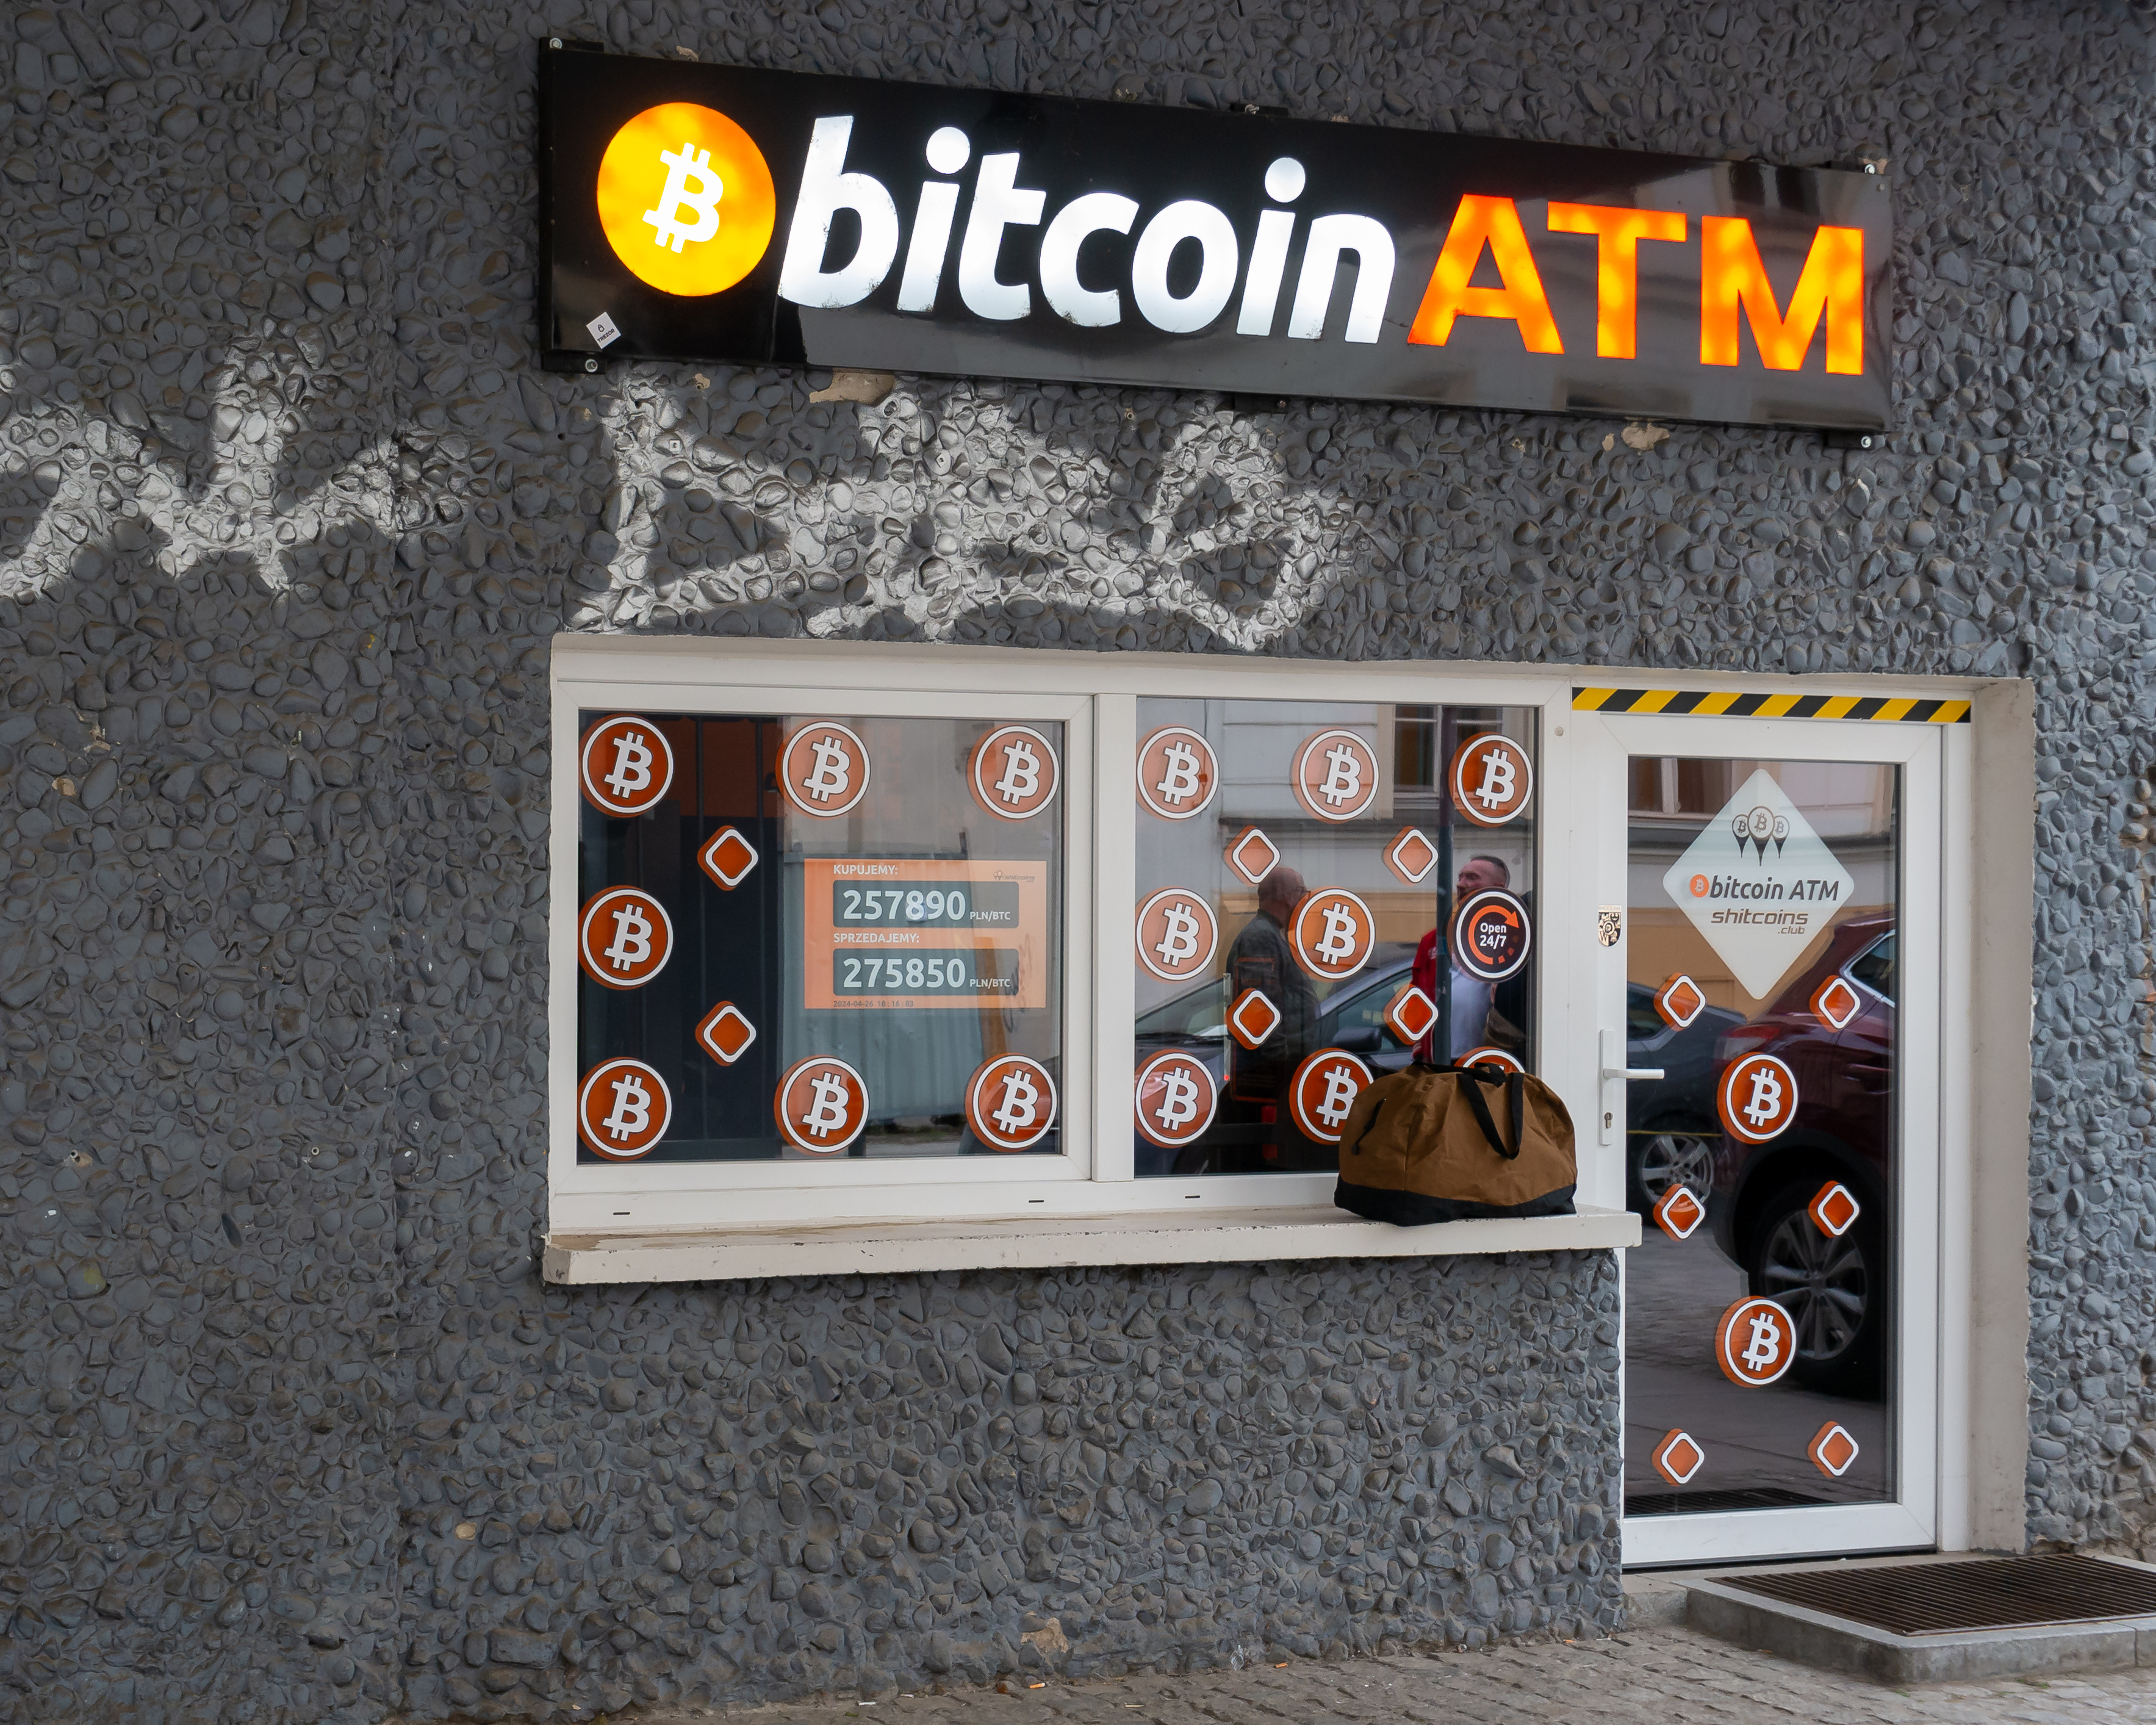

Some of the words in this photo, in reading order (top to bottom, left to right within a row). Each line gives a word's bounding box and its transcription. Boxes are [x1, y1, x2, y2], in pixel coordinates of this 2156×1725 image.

[778, 115, 1396, 343] bitcoin
[1407, 193, 1864, 376] ATM
[597, 328, 616, 343] TREZOR
[833, 865, 897, 875] KUPUJEMY:
[1709, 875, 1784, 900] bitcoin
[1788, 879, 1839, 901] ATM
[843, 890, 966, 920] 257890
[969, 912, 1011, 922] PLN/BTC
[1711, 908, 1808, 925] shitcoins
[1479, 922, 1507, 935] Open
[1777, 926, 1805, 934] .club
[833, 933, 919, 943] SPRZEDAJEMY:
[1479, 935, 1507, 949] 24/7
[843, 958, 966, 988] 275850
[969, 978, 1011, 989] PLN/BTC
